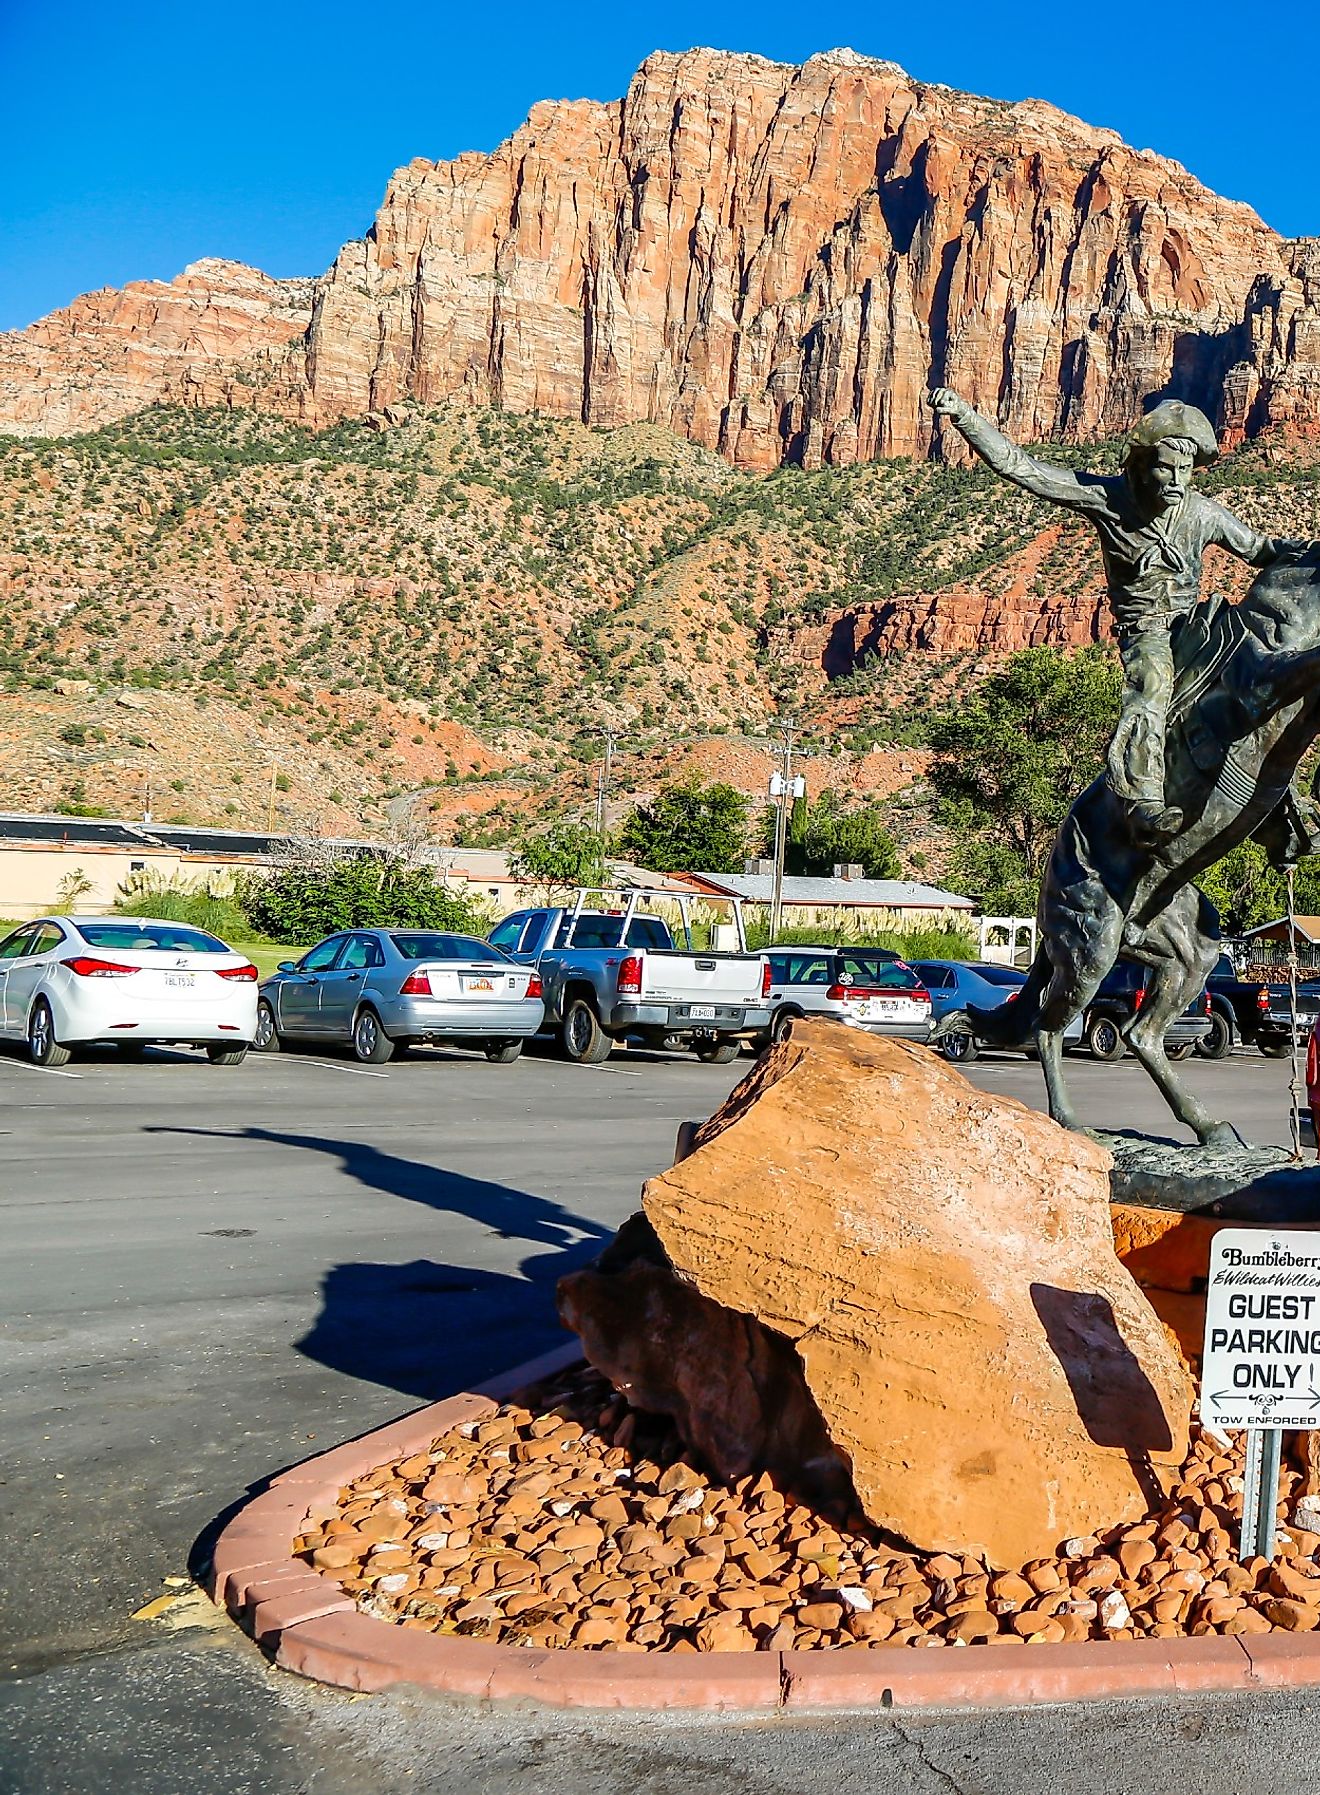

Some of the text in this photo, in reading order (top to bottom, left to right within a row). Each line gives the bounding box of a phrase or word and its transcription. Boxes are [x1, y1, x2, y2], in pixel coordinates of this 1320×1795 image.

[1229, 1294, 1316, 1320] GUEST
[1212, 1416, 1317, 1425] TOW ENFORCED
